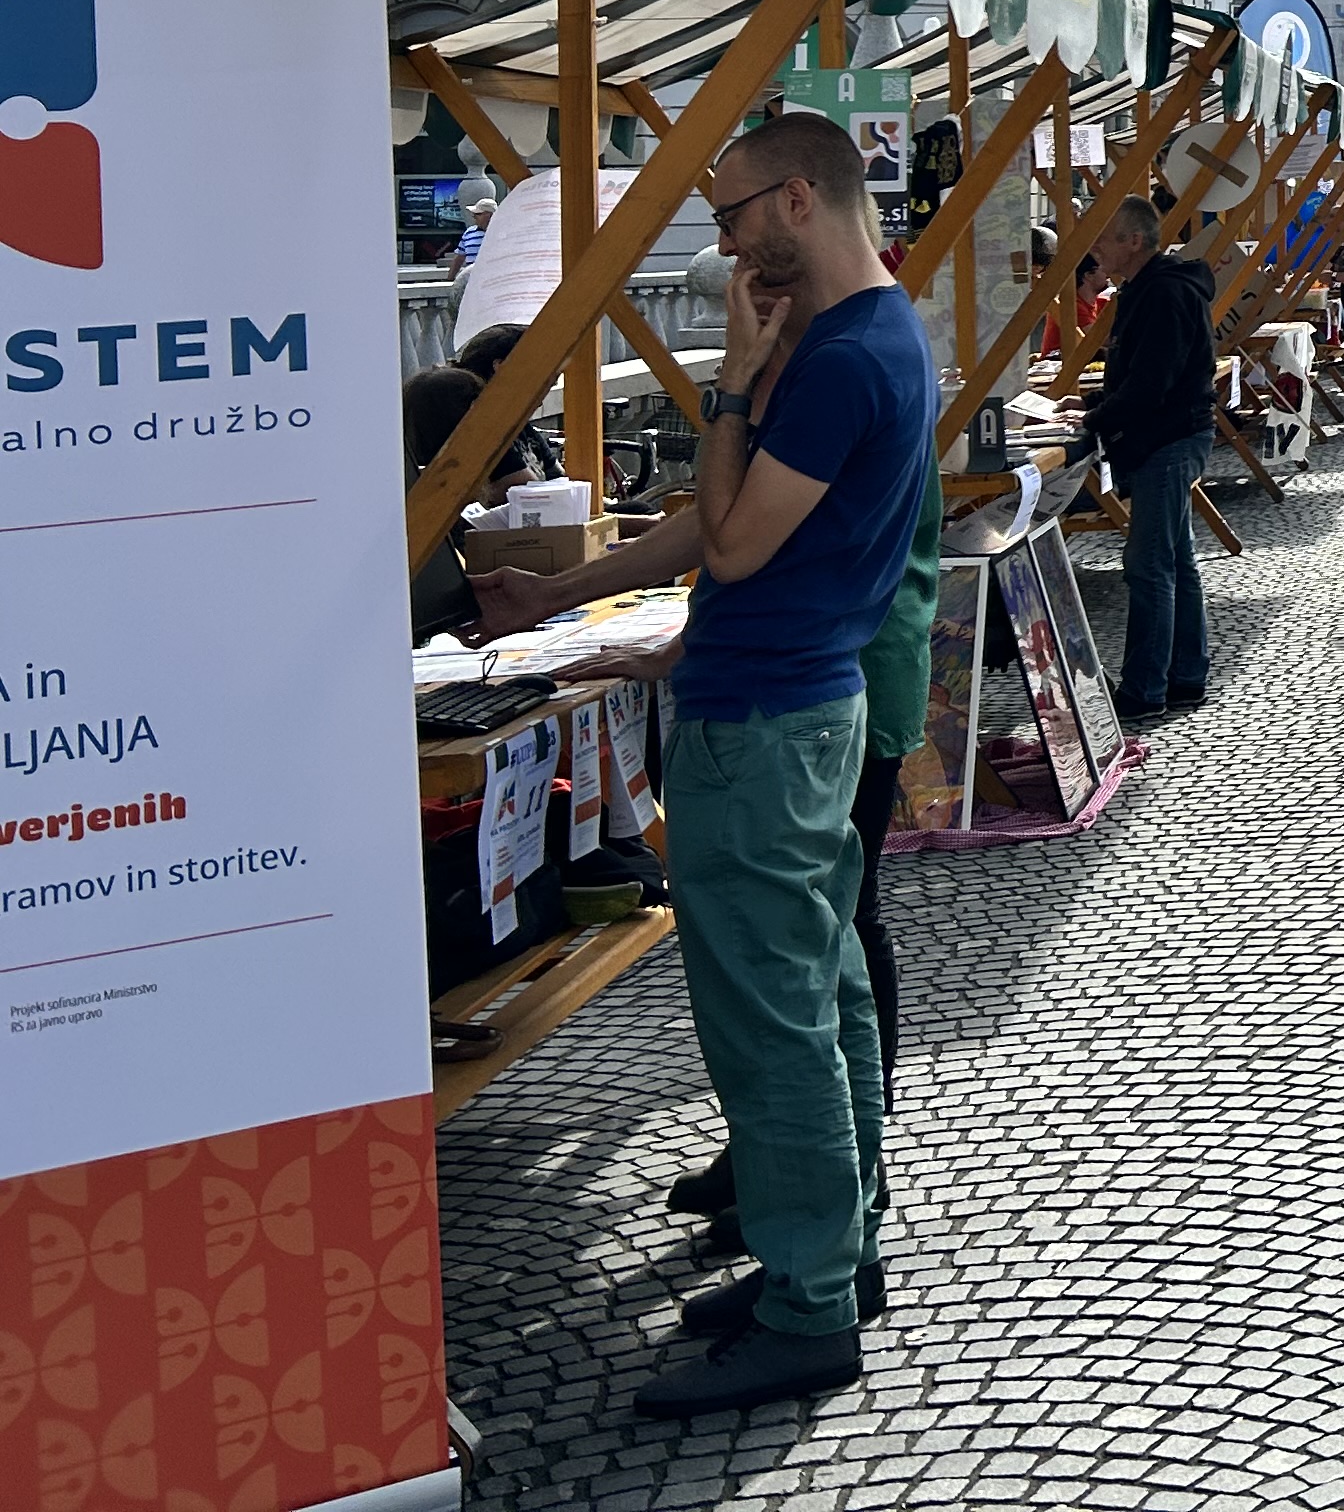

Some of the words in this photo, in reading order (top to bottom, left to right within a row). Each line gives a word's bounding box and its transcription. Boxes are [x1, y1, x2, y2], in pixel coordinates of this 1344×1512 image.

[5, 313, 308, 393] STEM
[2, 421, 112, 452] alno
[133, 404, 311, 441] družbo
[26, 663, 66, 699] in
[4, 715, 159, 775] LJANJA
[2, 874, 116, 912] ramov
[126, 865, 157, 892] in
[168, 846, 307, 886] storitev.
[10, 1002, 46, 1018] Projekt
[47, 992, 102, 1011] sofinancira
[103, 983, 158, 1001] Ministrstvo
[26, 1021, 37, 1031] za
[39, 1013, 67, 1031] javno
[68, 1008, 103, 1025] upravo
